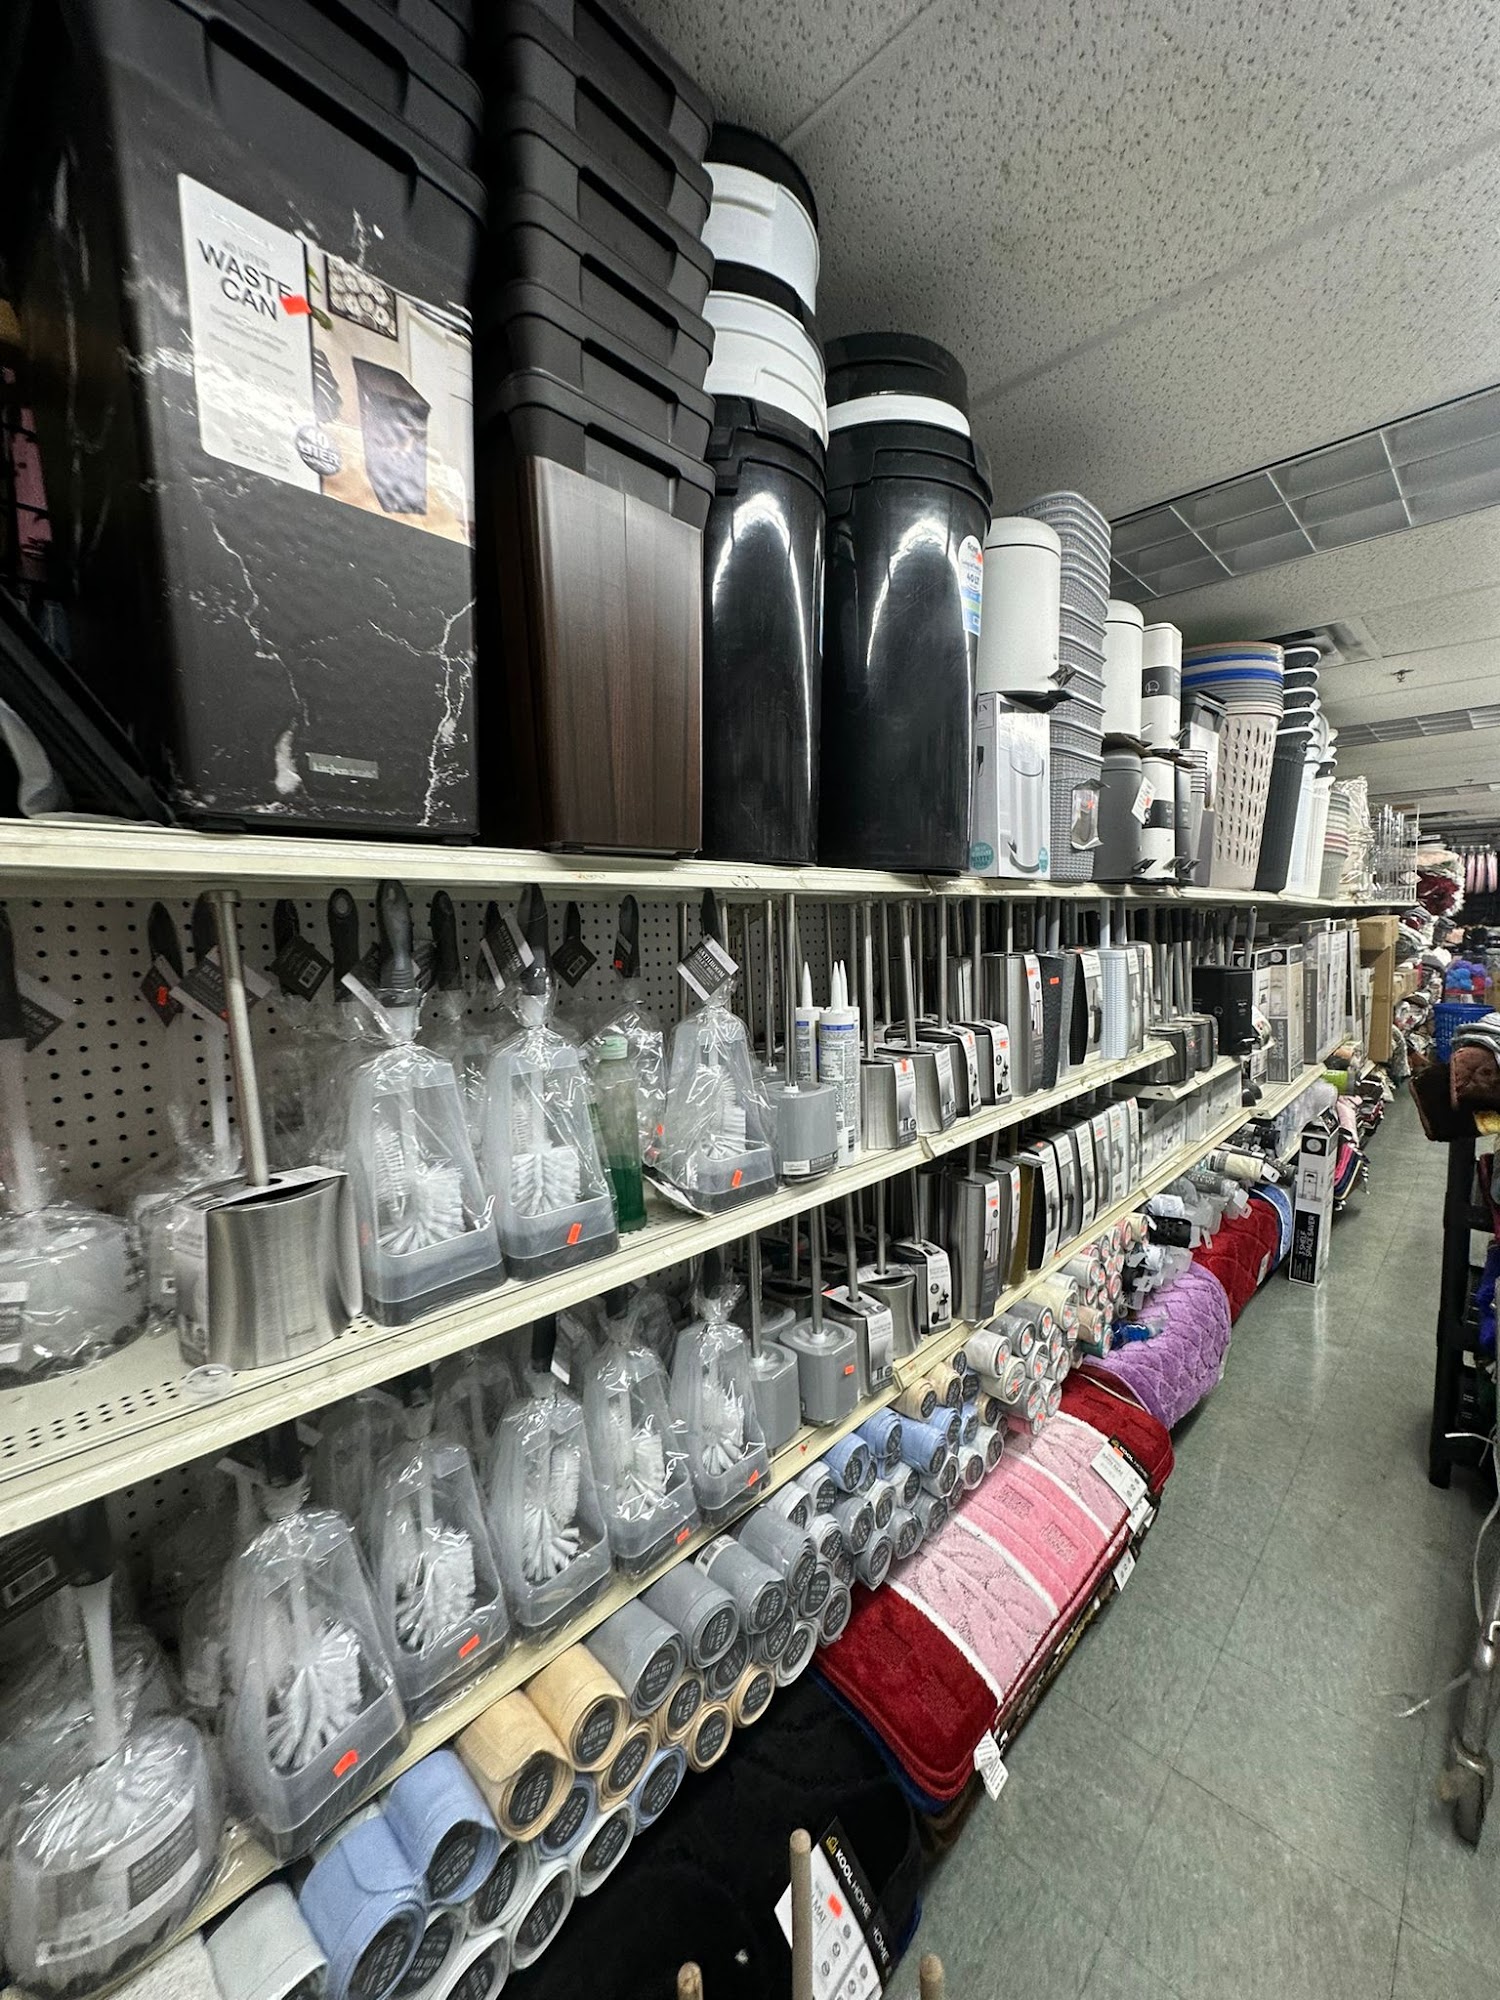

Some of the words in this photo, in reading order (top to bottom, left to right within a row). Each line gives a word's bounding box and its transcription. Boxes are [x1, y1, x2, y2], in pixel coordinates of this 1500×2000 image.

[197, 237, 293, 298] WASTE
[220, 276, 278, 322] CAN
[1307, 1214, 1315, 1236] SAVER
[834, 1848, 853, 1885] KOOL
[851, 1880, 872, 1920] HOME
